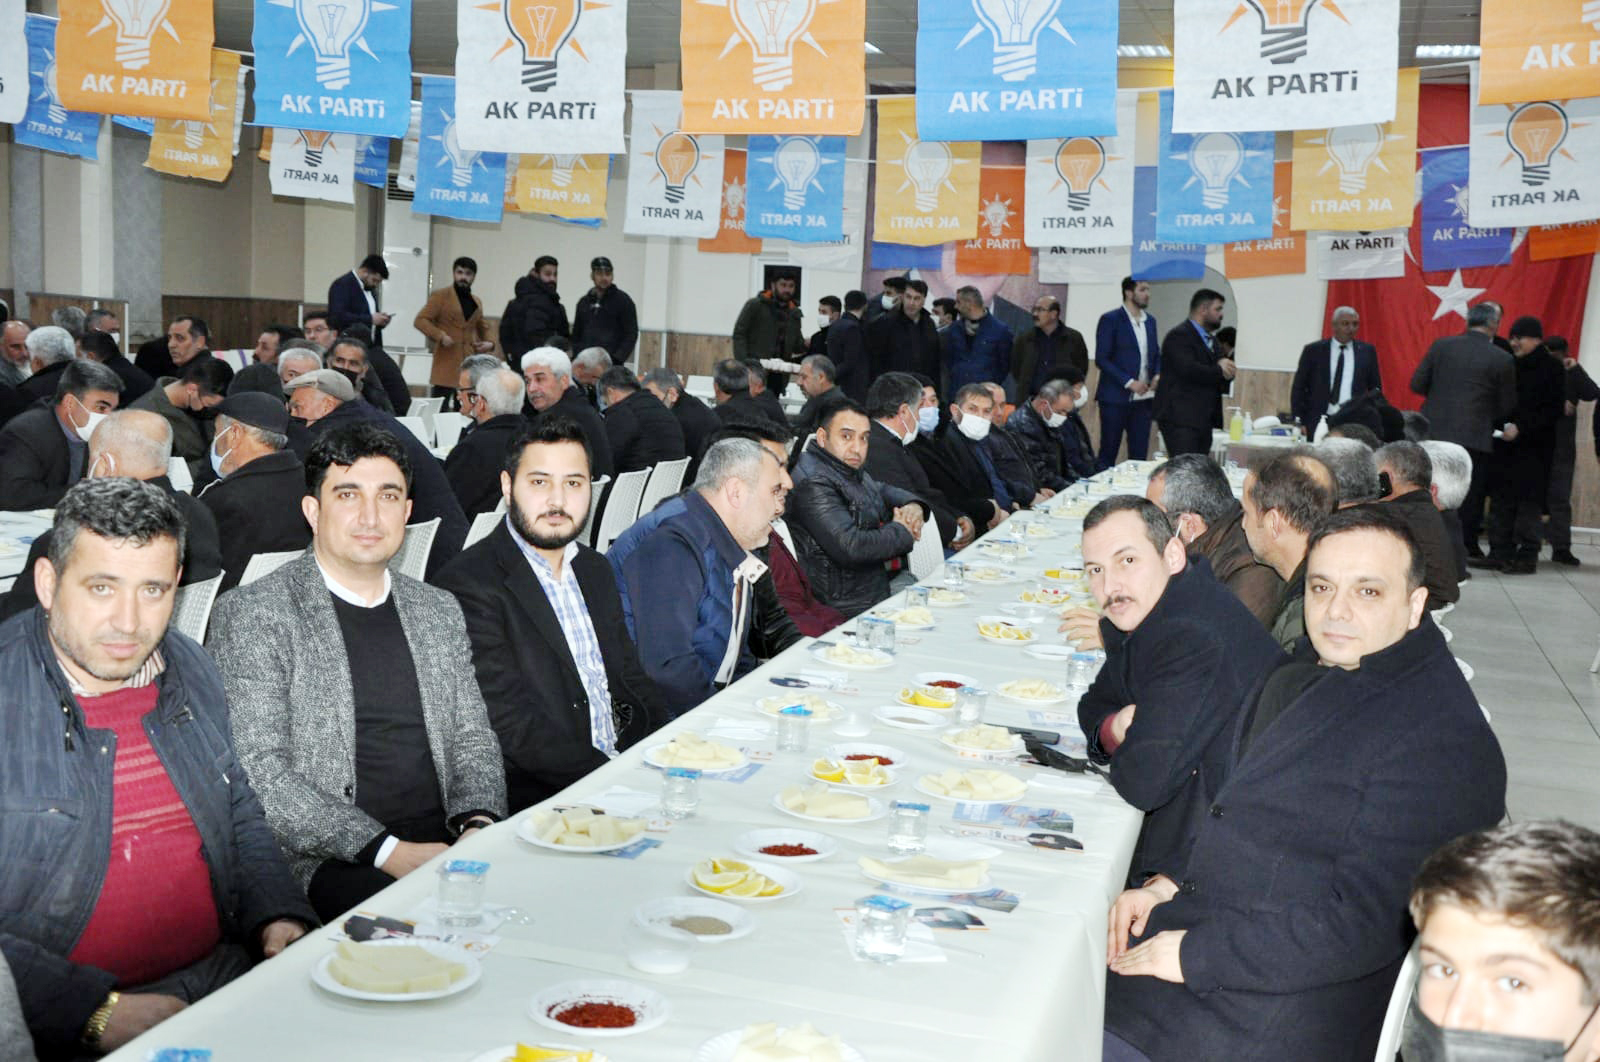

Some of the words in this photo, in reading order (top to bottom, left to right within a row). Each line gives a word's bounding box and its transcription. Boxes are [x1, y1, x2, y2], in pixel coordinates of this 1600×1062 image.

[1520, 42, 1576, 71] AK
[80, 73, 115, 94] AK
[1211, 76, 1256, 99] AK
[280, 94, 313, 114] AK
[485, 101, 519, 120] AK
[712, 98, 750, 120] AK
[947, 90, 991, 114] AK
[964, 238, 982, 249] AK
[1432, 228, 1453, 241] AK
[1050, 246, 1067, 255] AK
[1139, 239, 1157, 252] AK
[1233, 240, 1252, 252] AK
[1330, 238, 1350, 251] AK
